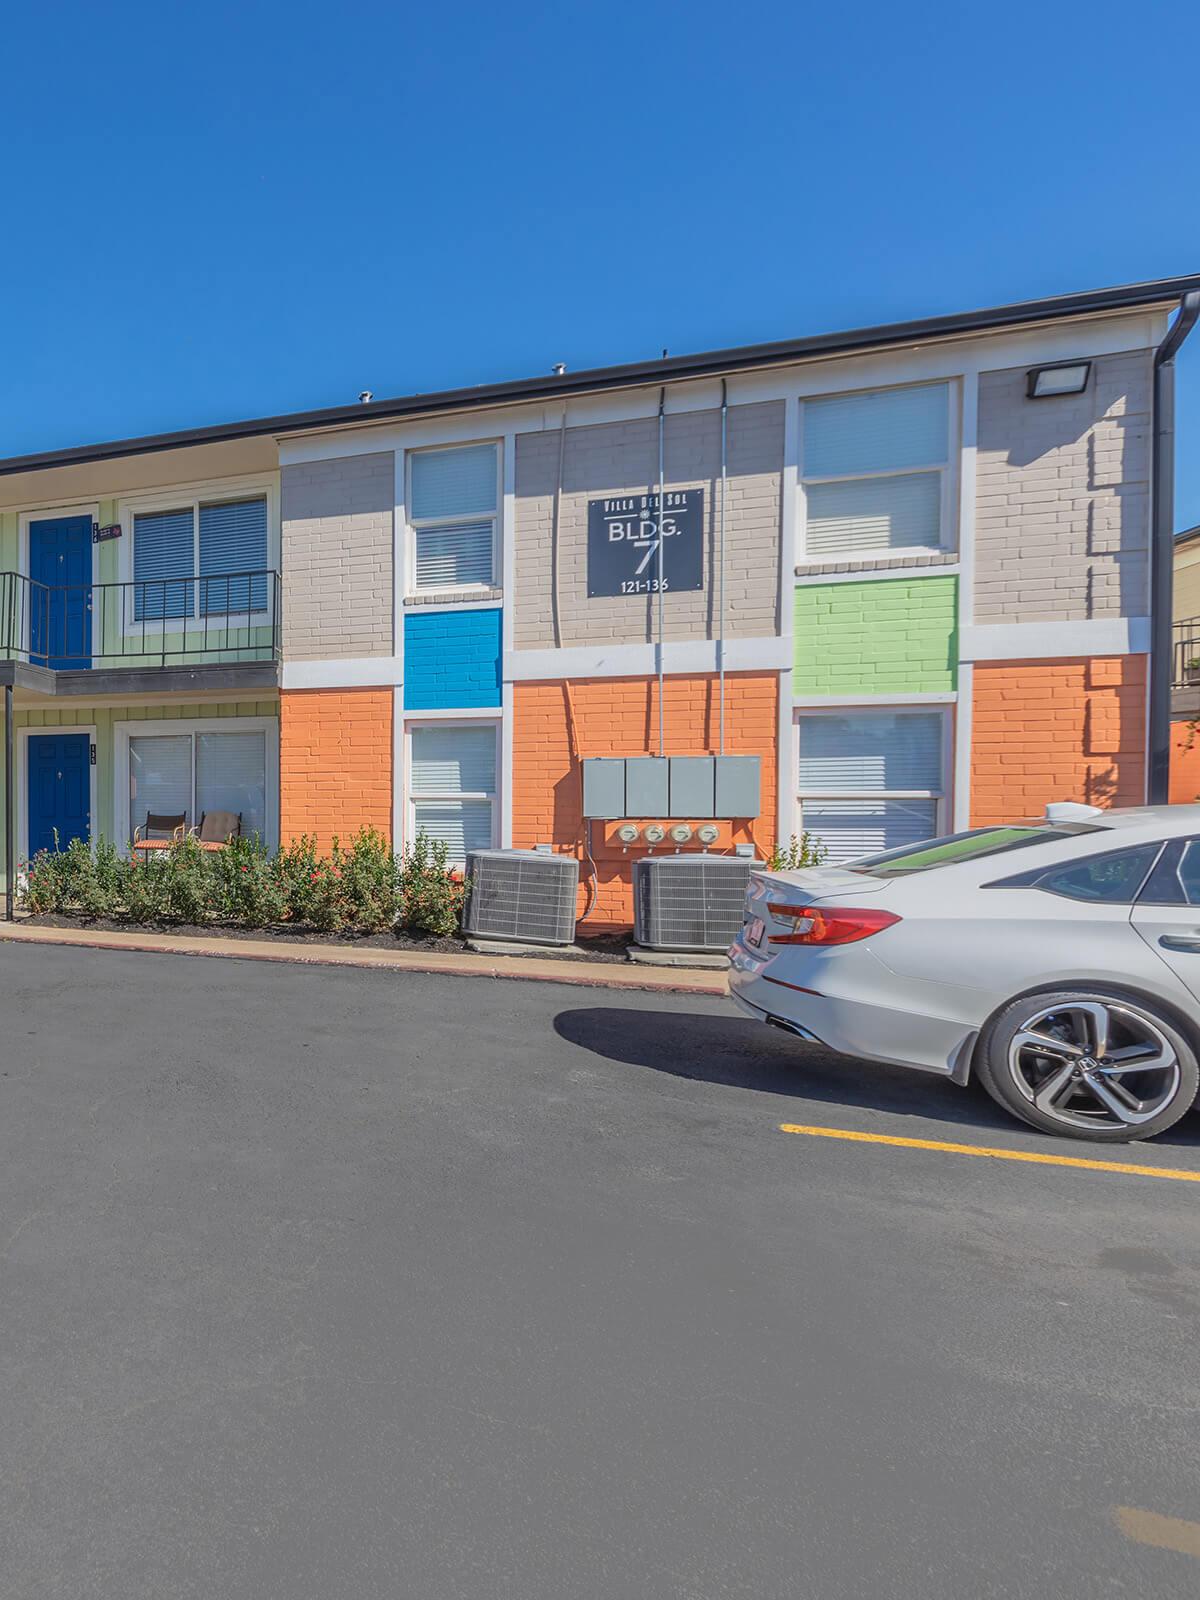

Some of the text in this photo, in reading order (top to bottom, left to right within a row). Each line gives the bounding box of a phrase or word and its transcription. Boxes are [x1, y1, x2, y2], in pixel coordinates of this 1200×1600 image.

[667, 493, 687, 506] SOL
[609, 519, 681, 541] BLDG.
[634, 540, 660, 575] 7
